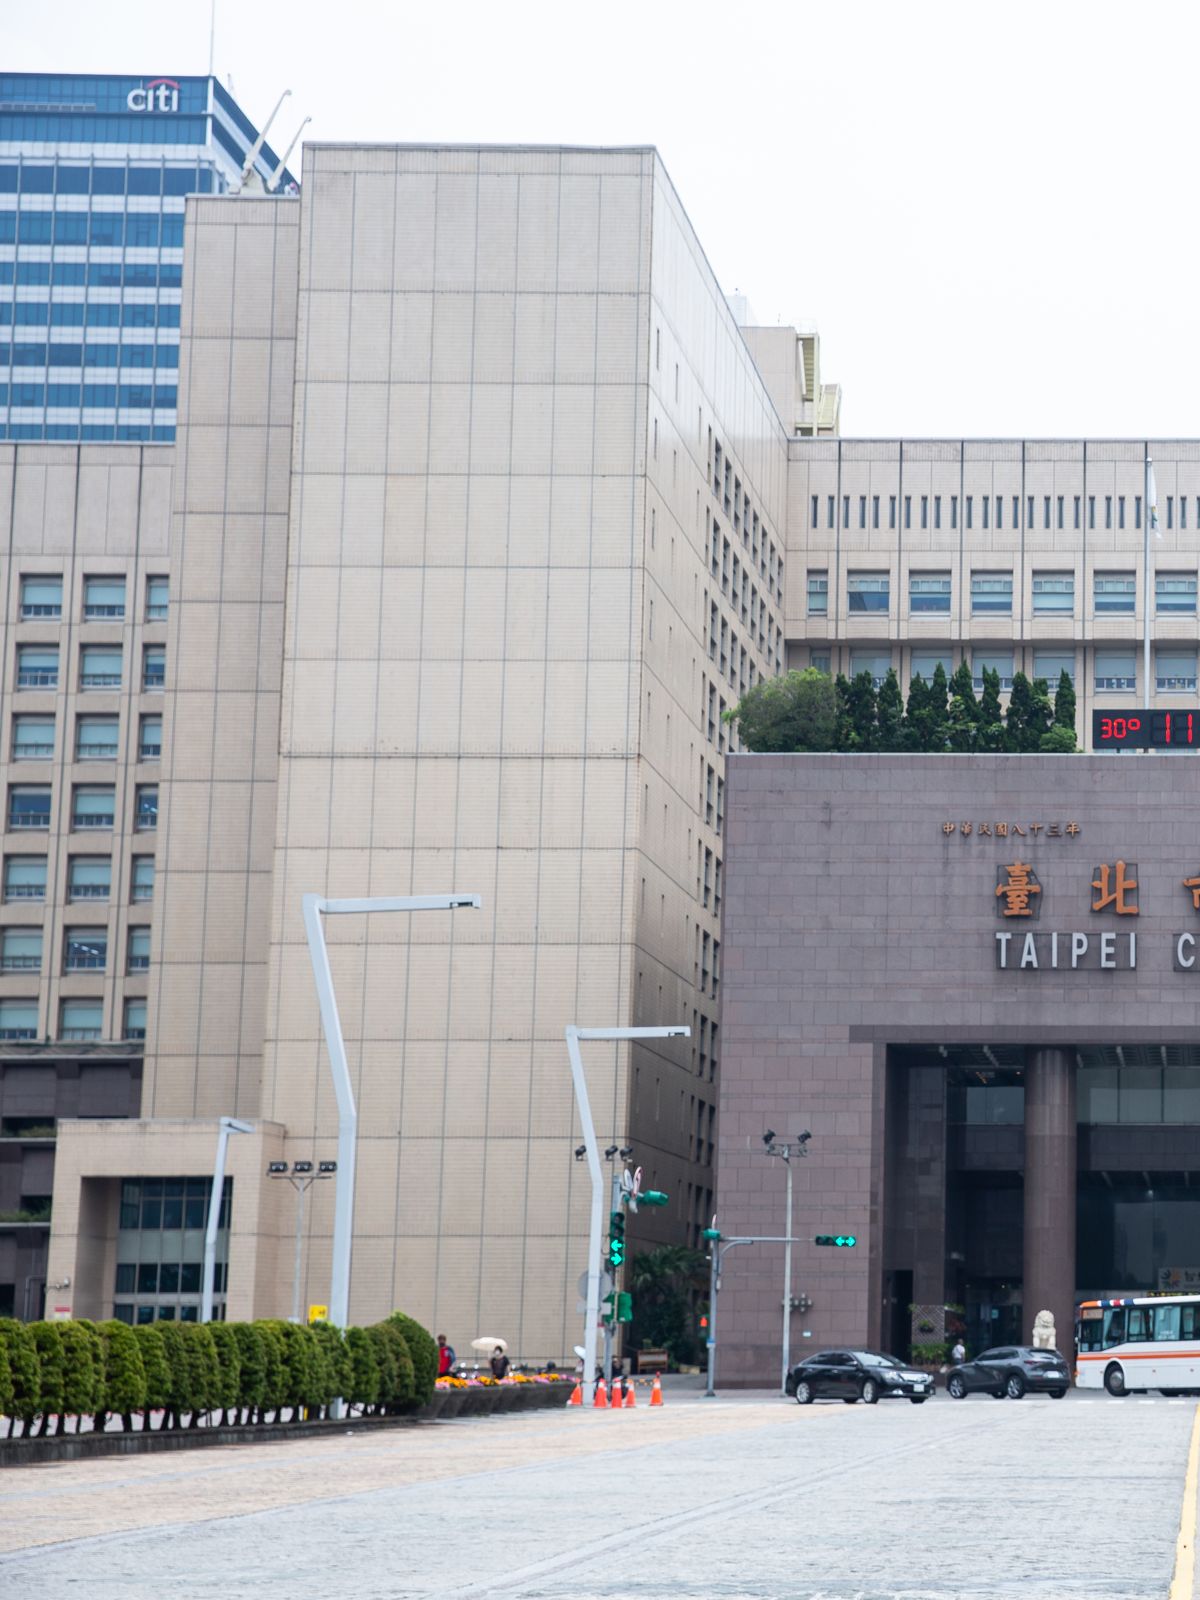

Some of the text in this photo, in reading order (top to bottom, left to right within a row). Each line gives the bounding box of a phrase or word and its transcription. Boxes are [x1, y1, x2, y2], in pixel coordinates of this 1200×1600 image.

[127, 80, 180, 112] citi
[942, 822, 1081, 837] 中華民國八十三年
[995, 932, 1137, 969] TAIPEI
